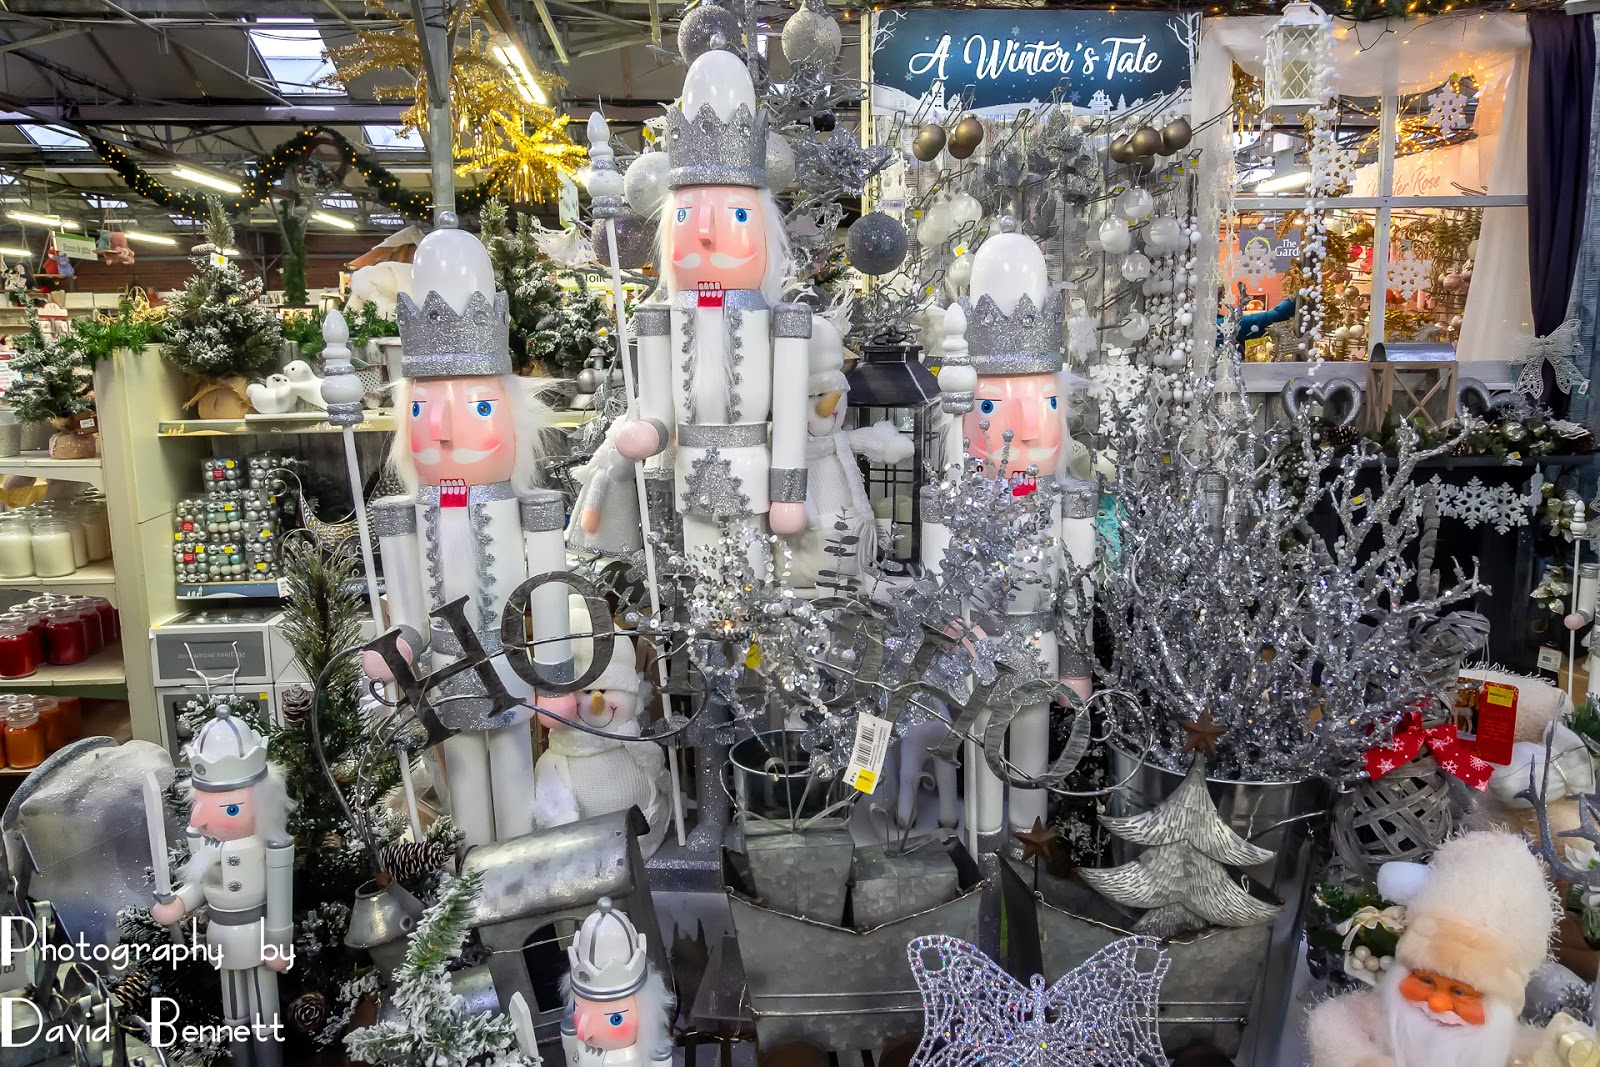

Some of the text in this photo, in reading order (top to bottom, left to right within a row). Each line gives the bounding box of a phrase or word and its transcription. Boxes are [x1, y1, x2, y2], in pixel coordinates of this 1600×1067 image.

[908, 34, 1162, 81] A Winter's Tale
[1411, 165, 1441, 195] Rose
[1283, 238, 1297, 248] The
